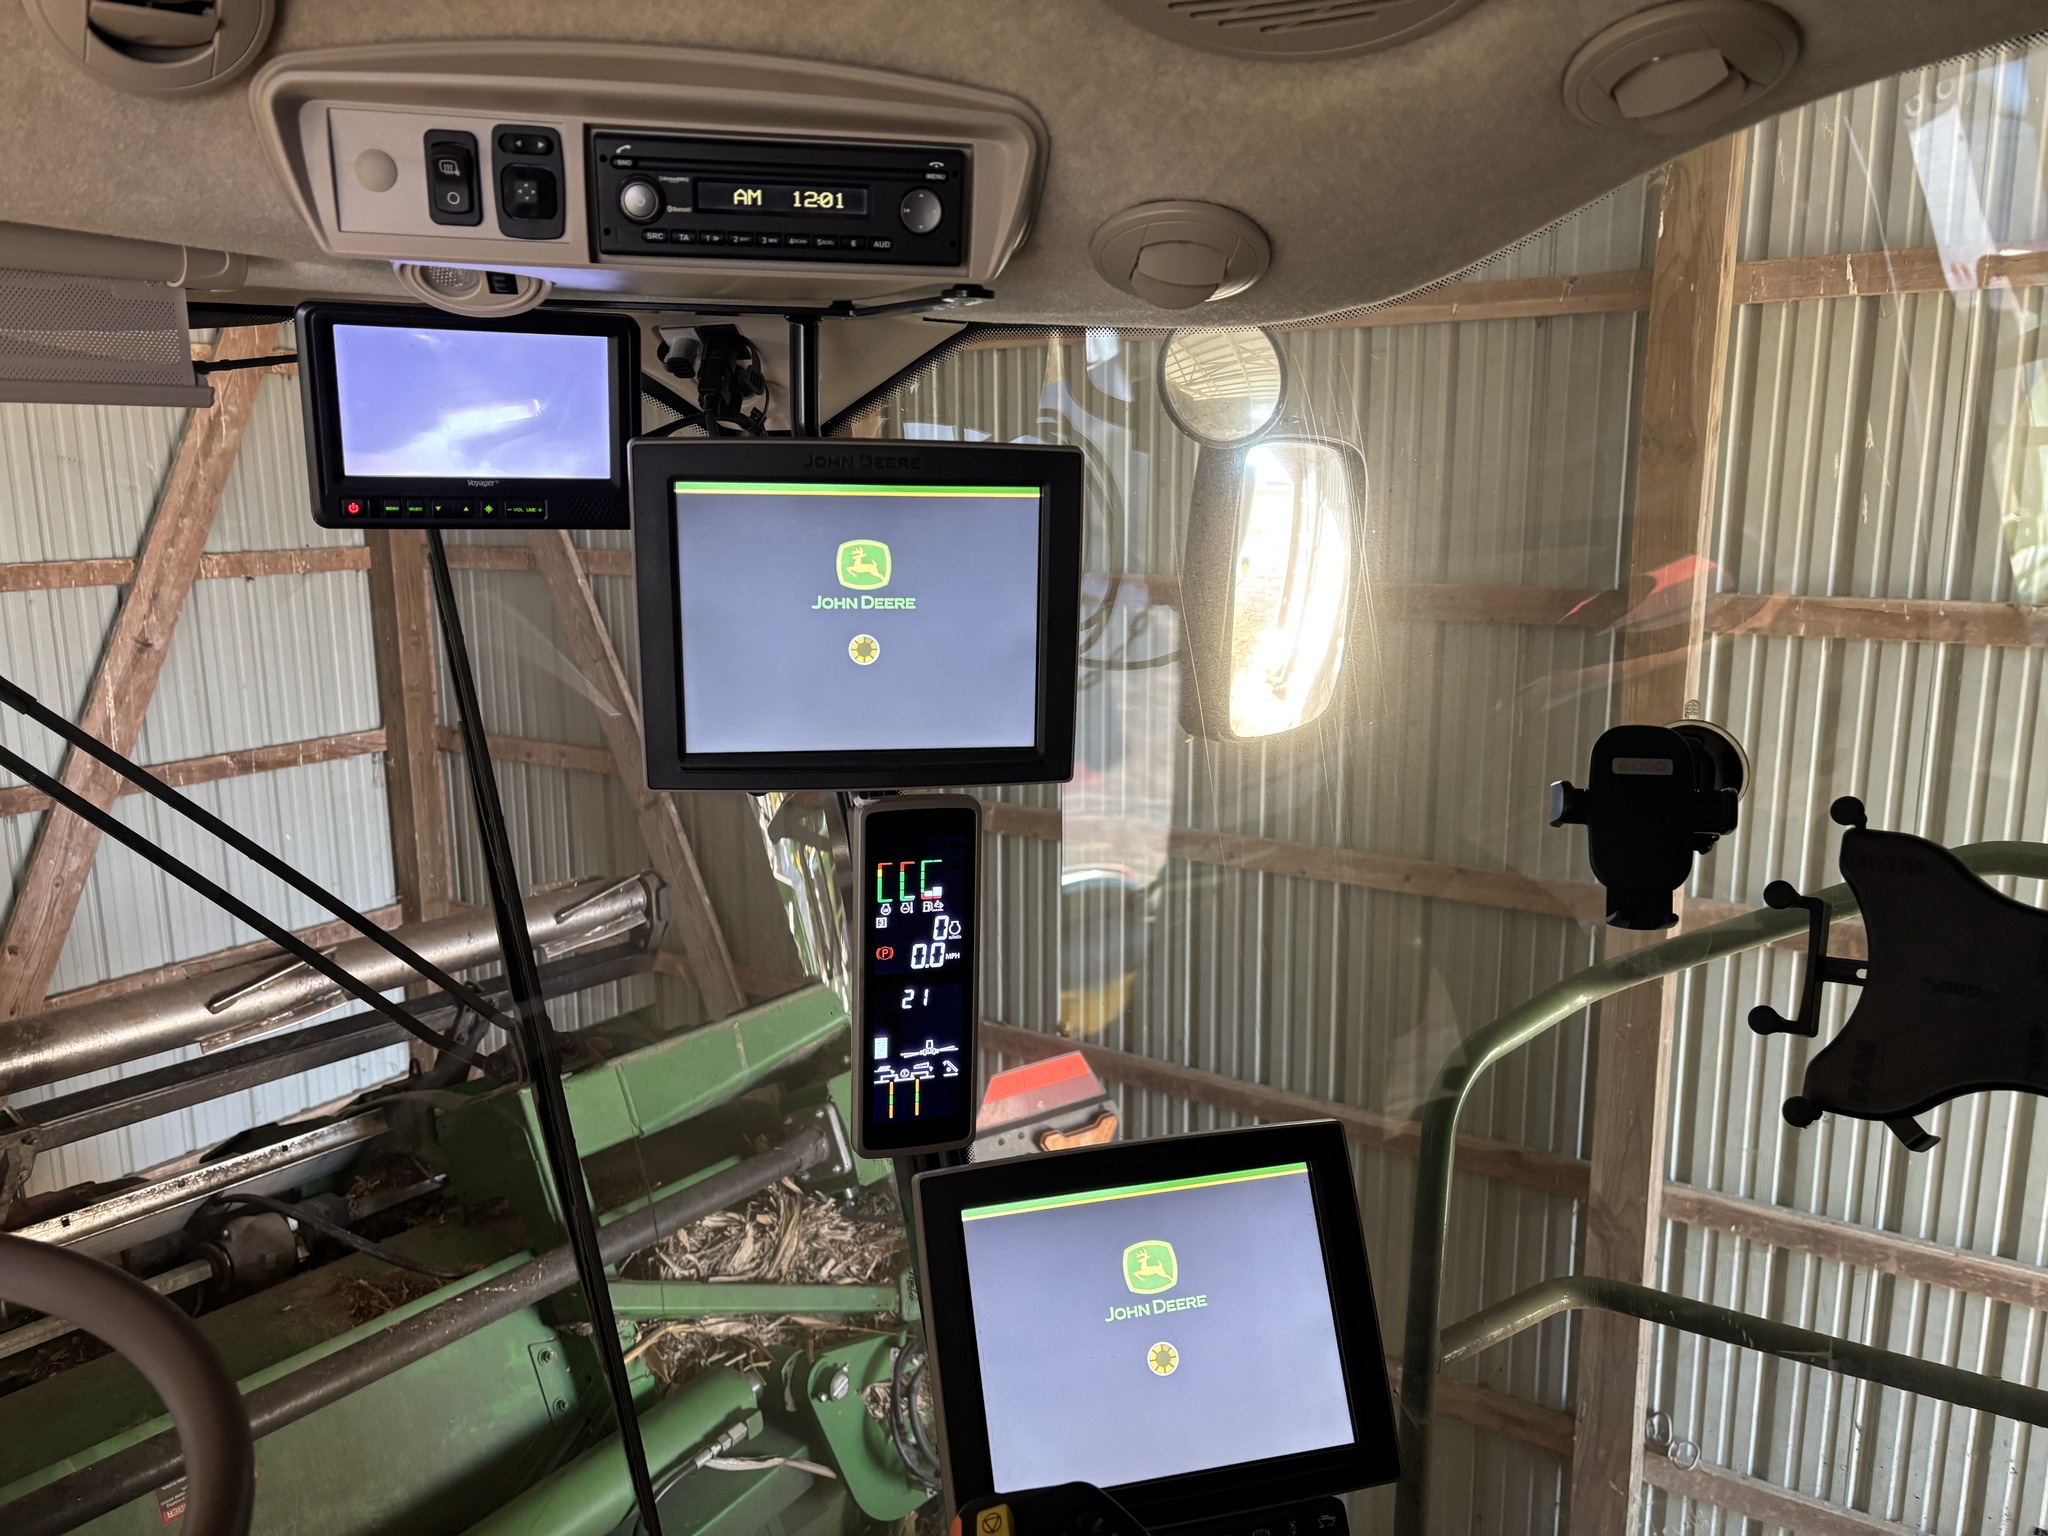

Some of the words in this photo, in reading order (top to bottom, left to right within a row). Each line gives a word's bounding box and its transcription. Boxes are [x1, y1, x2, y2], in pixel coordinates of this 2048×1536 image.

[616, 159, 633, 167] BND
[925, 172, 946, 181] MENU
[733, 188, 763, 206] AM
[793, 190, 844, 209] 12:01
[646, 232, 664, 241] SRC
[679, 233, 690, 242] TA
[705, 234, 710, 242] 1
[733, 235, 739, 243] 2
[761, 236, 768, 245] 3
[850, 239, 857, 247] 6
[873, 240, 891, 249] AUD
[803, 453, 854, 469] JOHN
[859, 454, 921, 470] DEERE
[467, 479, 496, 488] Voyager
[811, 595, 858, 610] JOHN
[861, 595, 916, 610] DEERE
[881, 948, 889, 958] P
[911, 942, 945, 969] 0.0
[945, 952, 960, 960] MPH
[1105, 1304, 1151, 1322] JOHN
[1152, 1295, 1208, 1315] DEERE
[167, 1503, 186, 1518] GER
